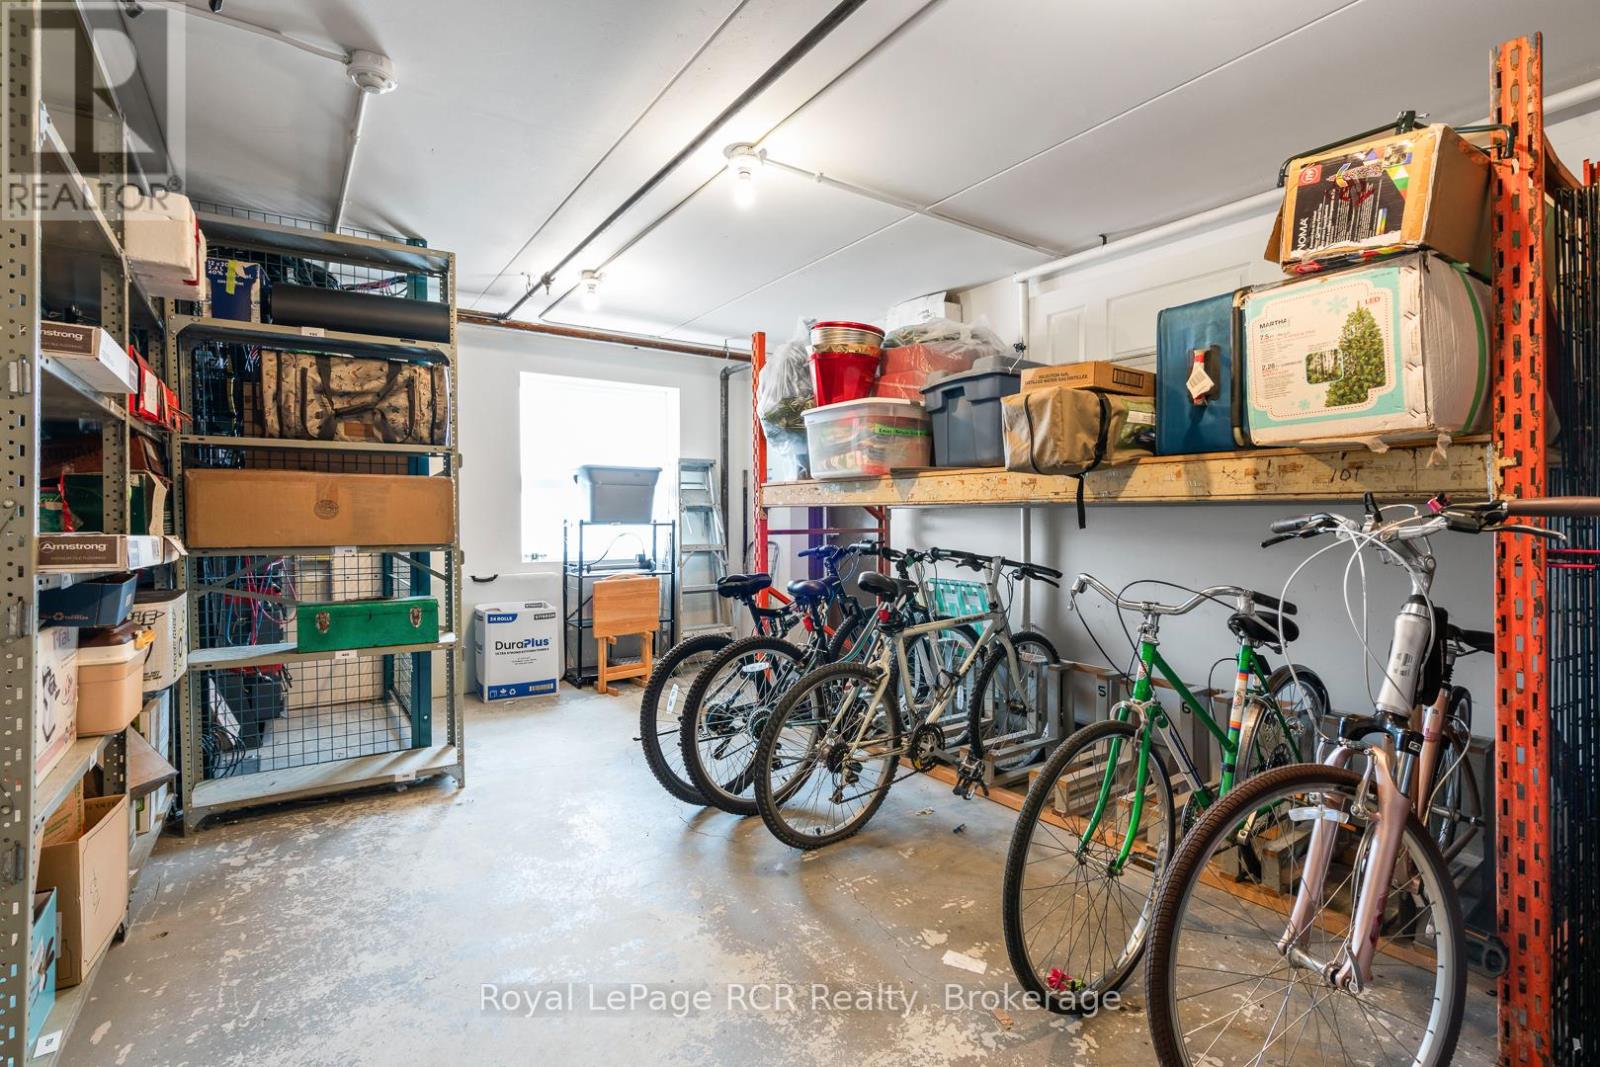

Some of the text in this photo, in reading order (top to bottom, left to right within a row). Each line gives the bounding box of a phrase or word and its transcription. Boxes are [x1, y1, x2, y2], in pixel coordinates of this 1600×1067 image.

[1297, 217, 1309, 251] NOMA
[1259, 318, 1288, 330] MARTHA
[40, 541, 107, 553] Armstrong
[495, 637, 550, 651] DuraPlus
[1097, 685, 1107, 697] 5
[1181, 702, 1192, 714] 6
